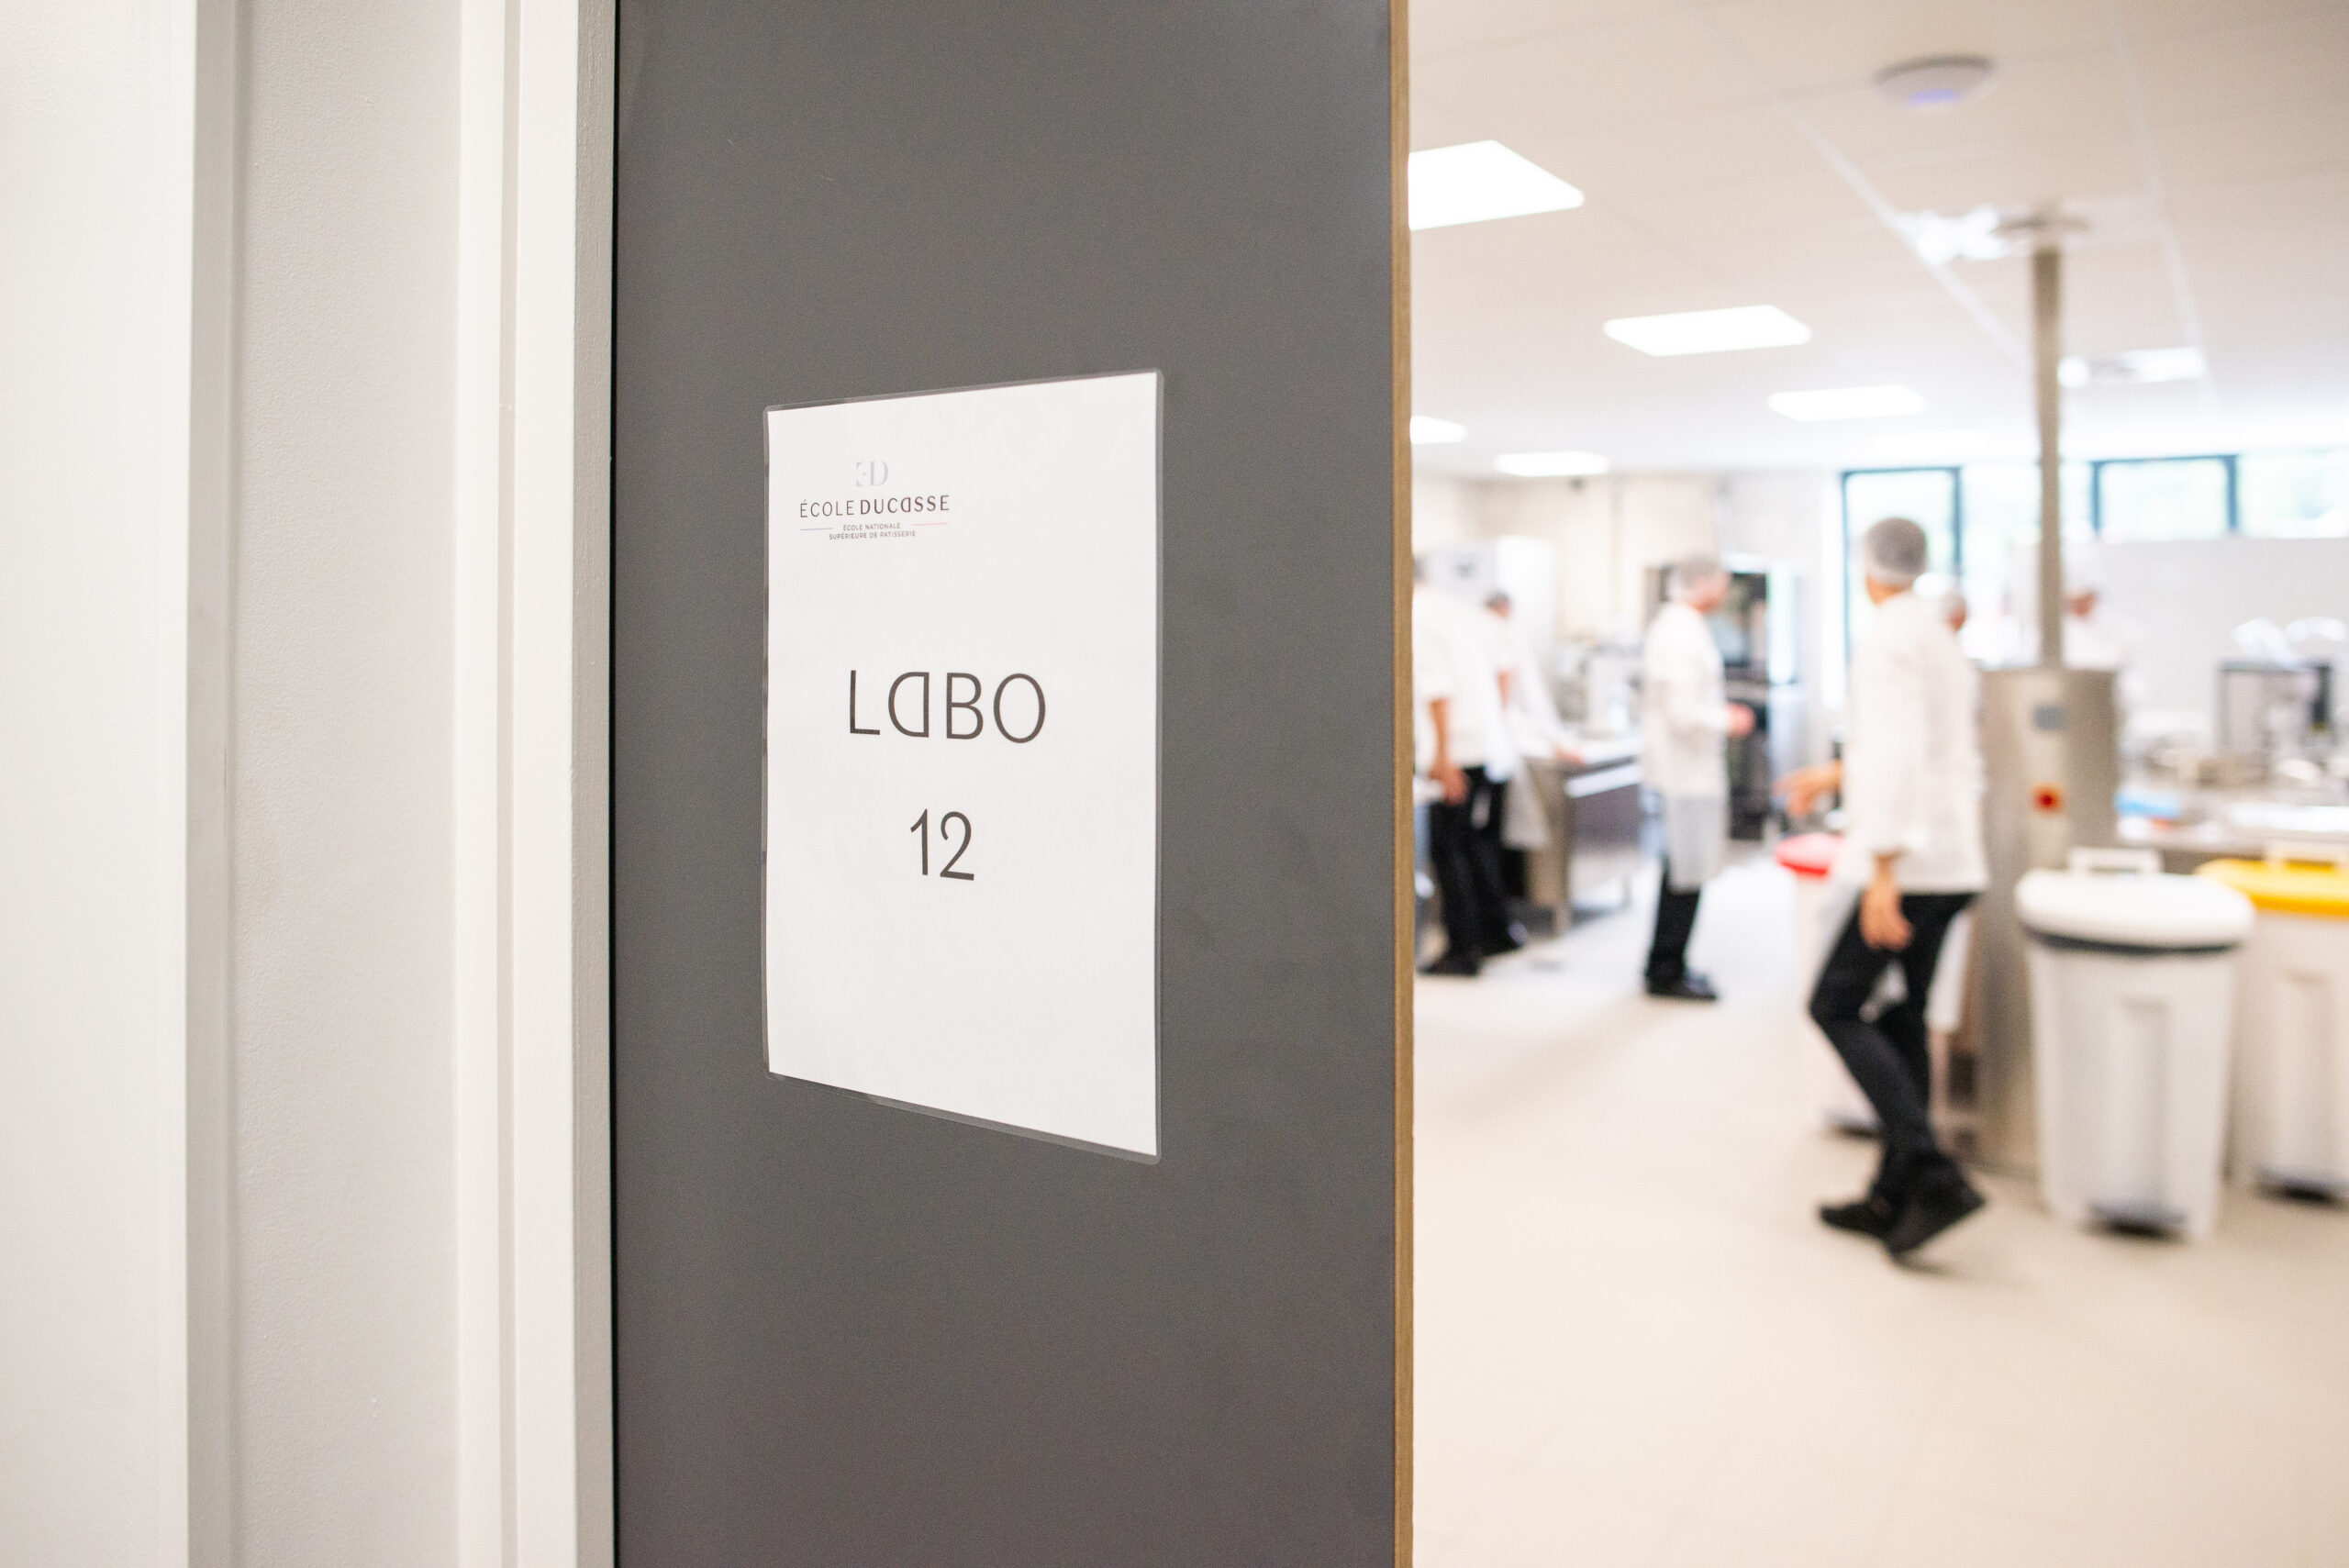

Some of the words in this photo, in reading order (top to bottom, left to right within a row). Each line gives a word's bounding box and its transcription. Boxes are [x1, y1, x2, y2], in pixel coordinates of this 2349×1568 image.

[800, 498, 854, 518] ÉCOLE
[829, 532, 867, 540] SUPÉRIEURE
[849, 669, 1046, 744] LABO
[910, 808, 975, 882] 12
